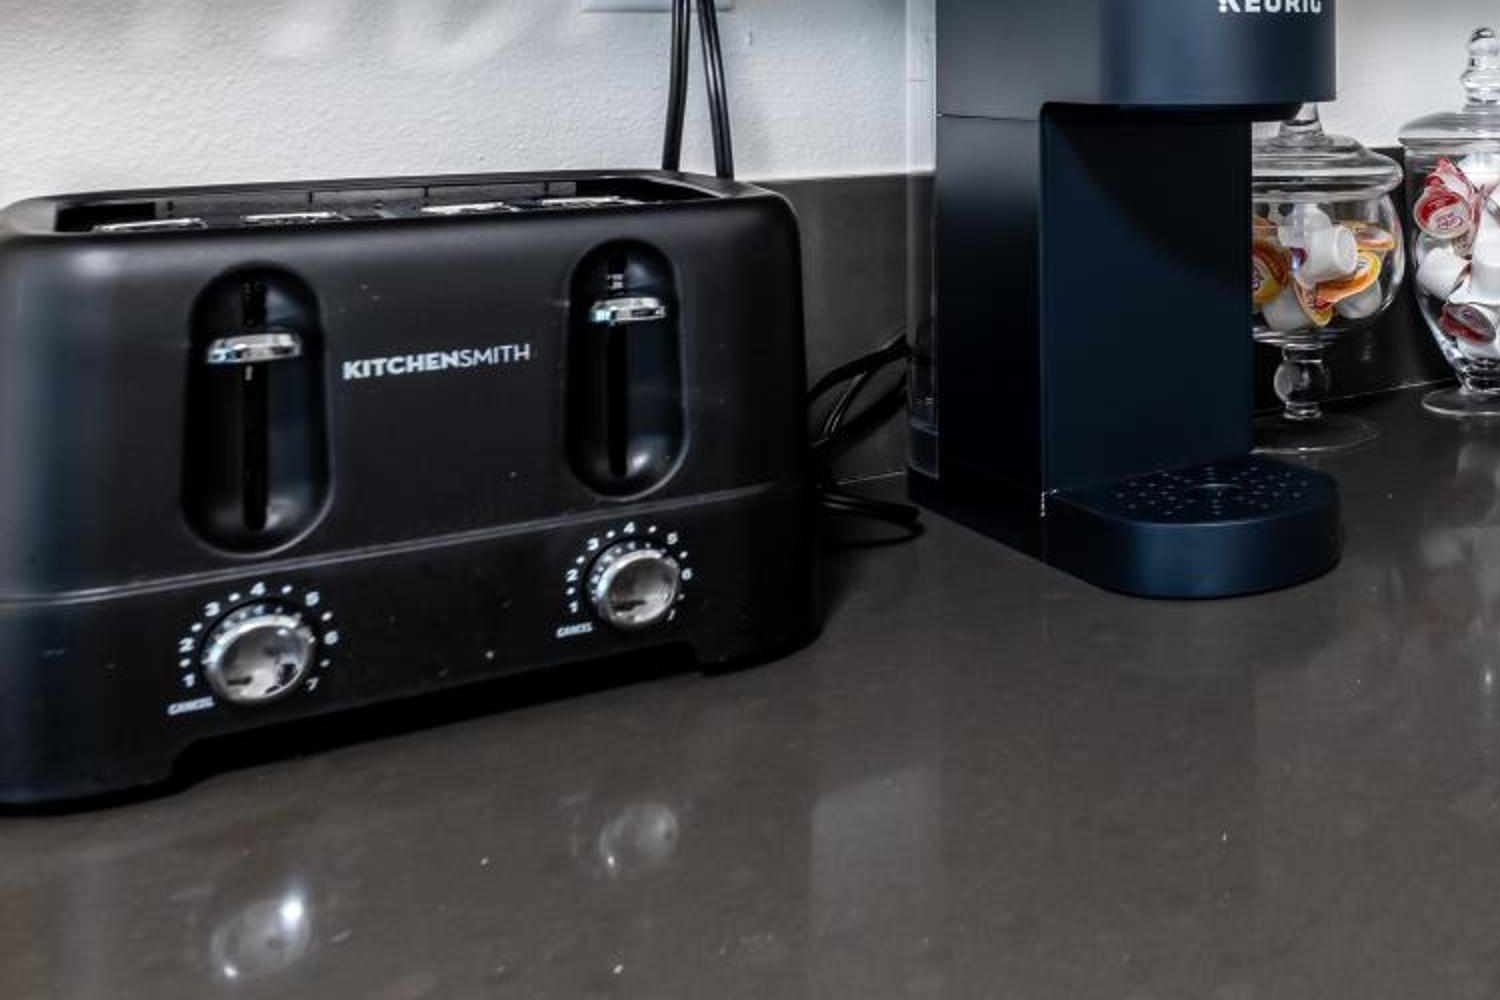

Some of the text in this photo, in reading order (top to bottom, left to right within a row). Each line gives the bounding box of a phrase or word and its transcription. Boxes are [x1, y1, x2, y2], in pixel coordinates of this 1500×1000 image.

[341, 342, 531, 381] KITCHENSMITH
[623, 521, 636, 533] 4
[587, 537, 600, 550] 3
[666, 532, 679, 544] 5
[565, 568, 579, 582] 2
[568, 601, 579, 613] 1
[179, 581, 339, 691] 1 2 3 4 5 6 7
